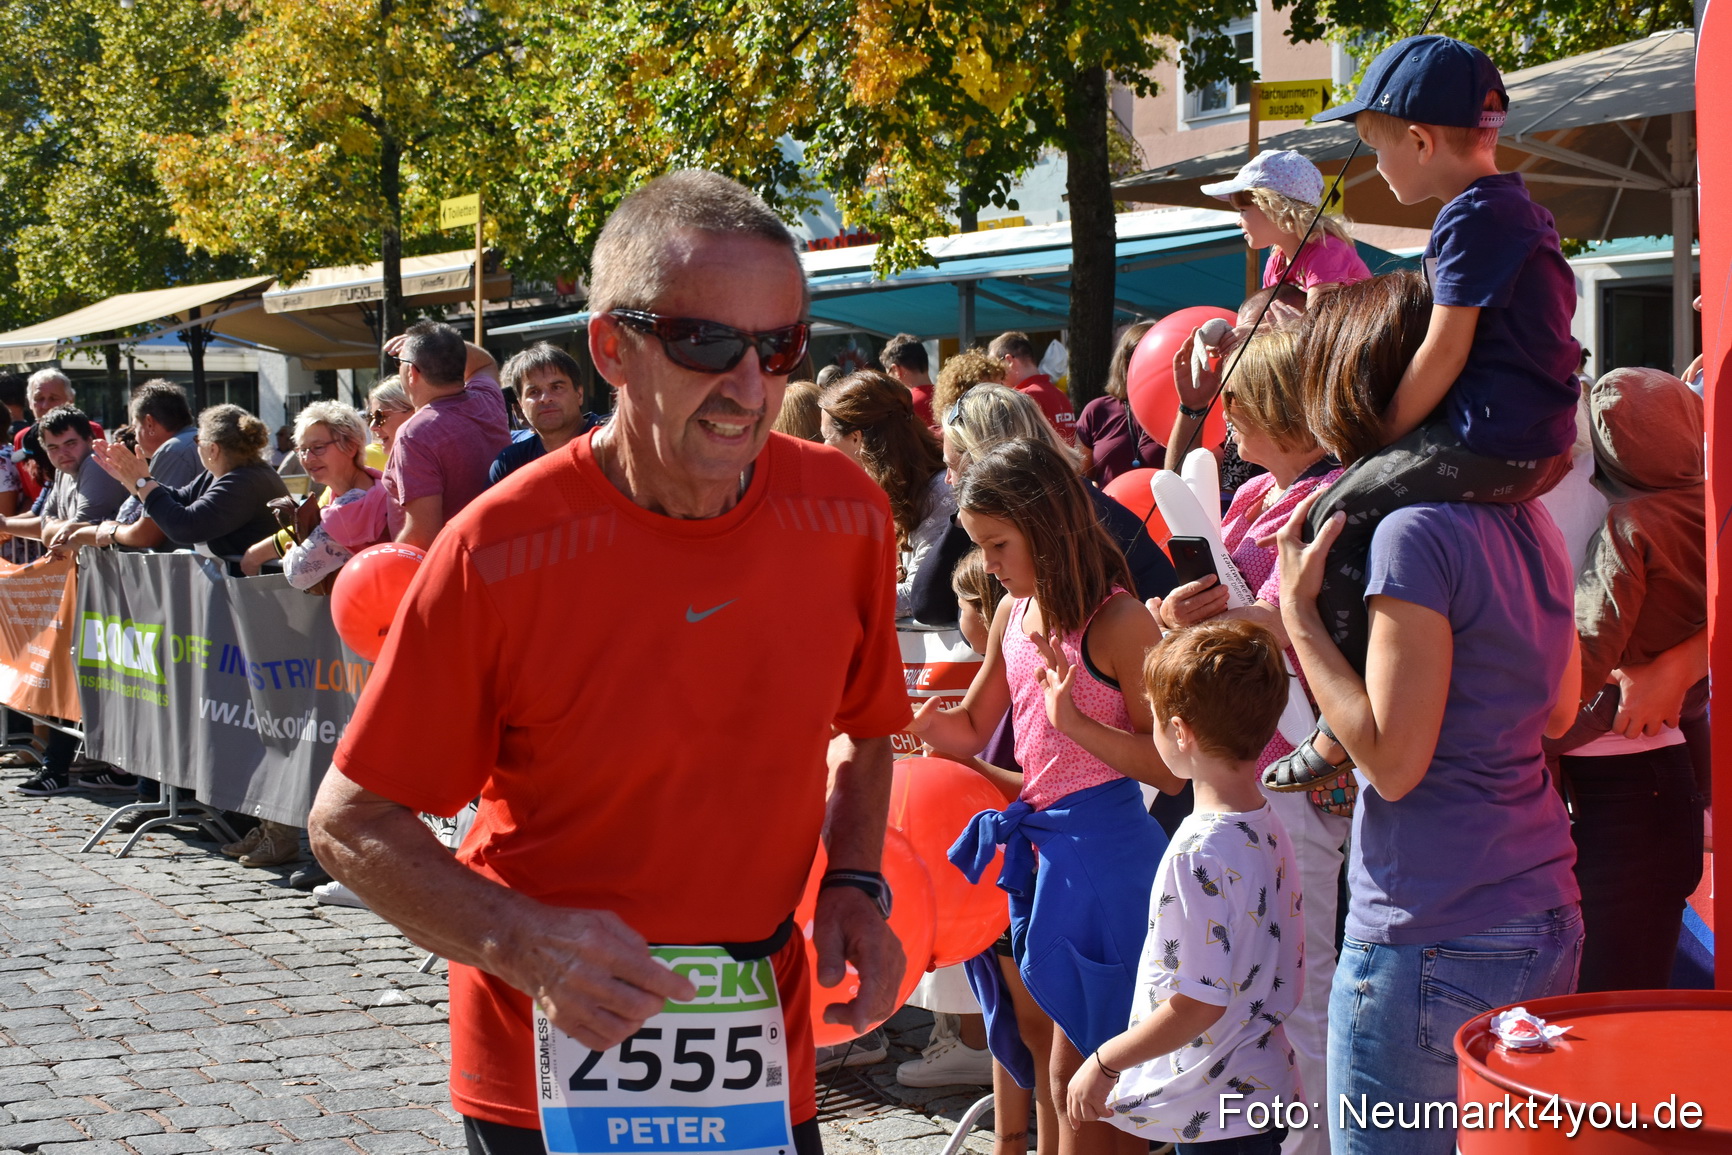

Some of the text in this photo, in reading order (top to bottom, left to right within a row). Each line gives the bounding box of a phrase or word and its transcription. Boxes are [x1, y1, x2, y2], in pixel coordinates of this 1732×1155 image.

[1259, 88, 1319, 101] tartnummern-
[1268, 103, 1305, 118] ausgabe
[448, 206, 477, 219] Toiletten
[82, 618, 159, 677] BOCK
[770, 1027, 778, 1040] D
[567, 1025, 763, 1093] 2555
[607, 1116, 726, 1145] PETER
